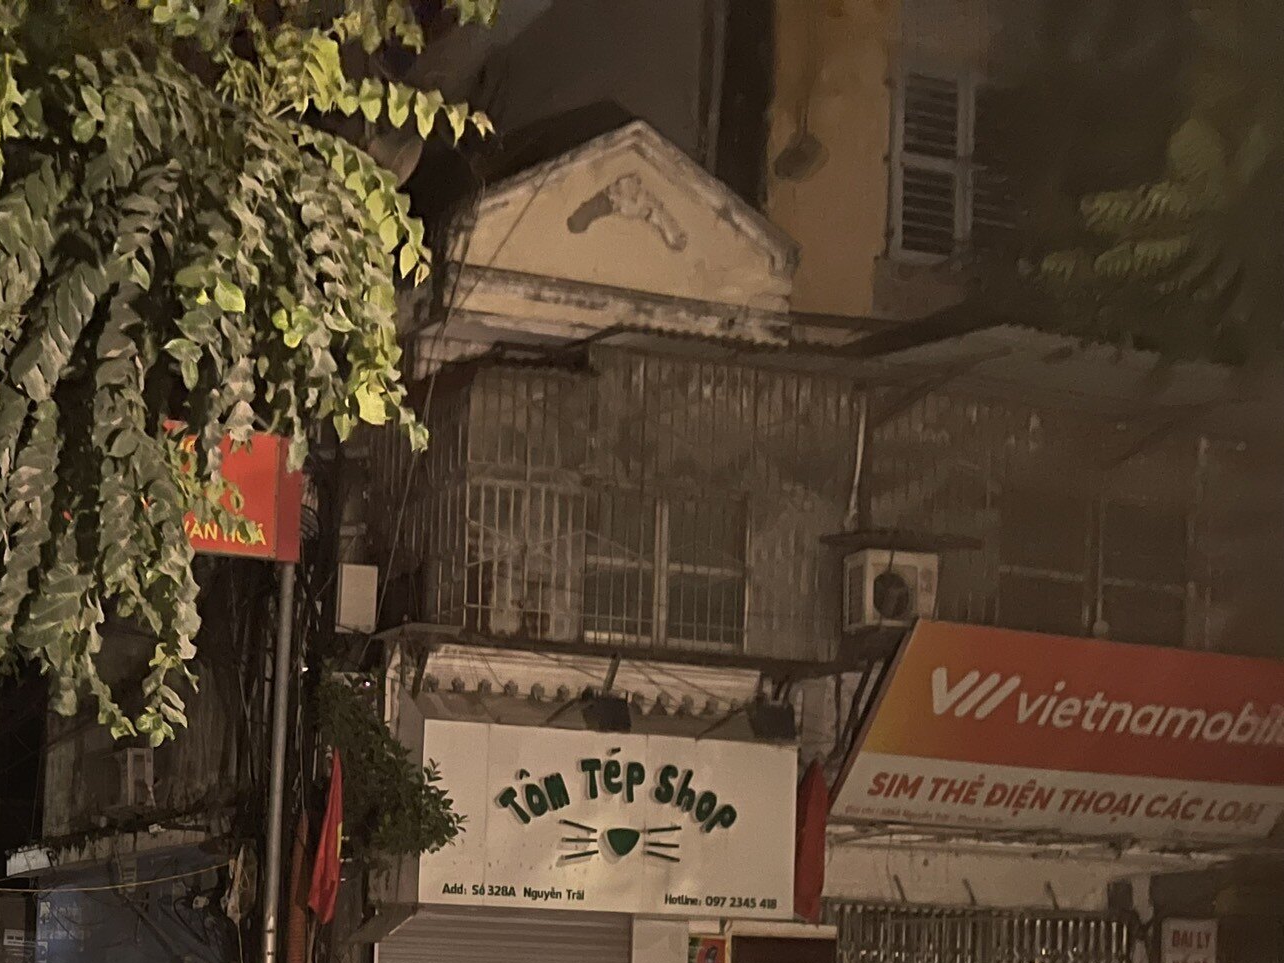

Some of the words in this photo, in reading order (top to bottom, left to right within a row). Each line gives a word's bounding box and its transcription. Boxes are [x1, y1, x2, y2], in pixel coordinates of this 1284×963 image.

[654, 764, 737, 833] Shop
[866, 771, 924, 800] SIM
[928, 773, 986, 806] THẺ
[982, 778, 1056, 817] ĐIỆN
[1058, 787, 1144, 824] THOẠI
[1145, 790, 1204, 822] CÁC
[488, 885, 516, 898] 328A
[705, 896, 727, 907] 097
[729, 897, 757, 909] 2345
